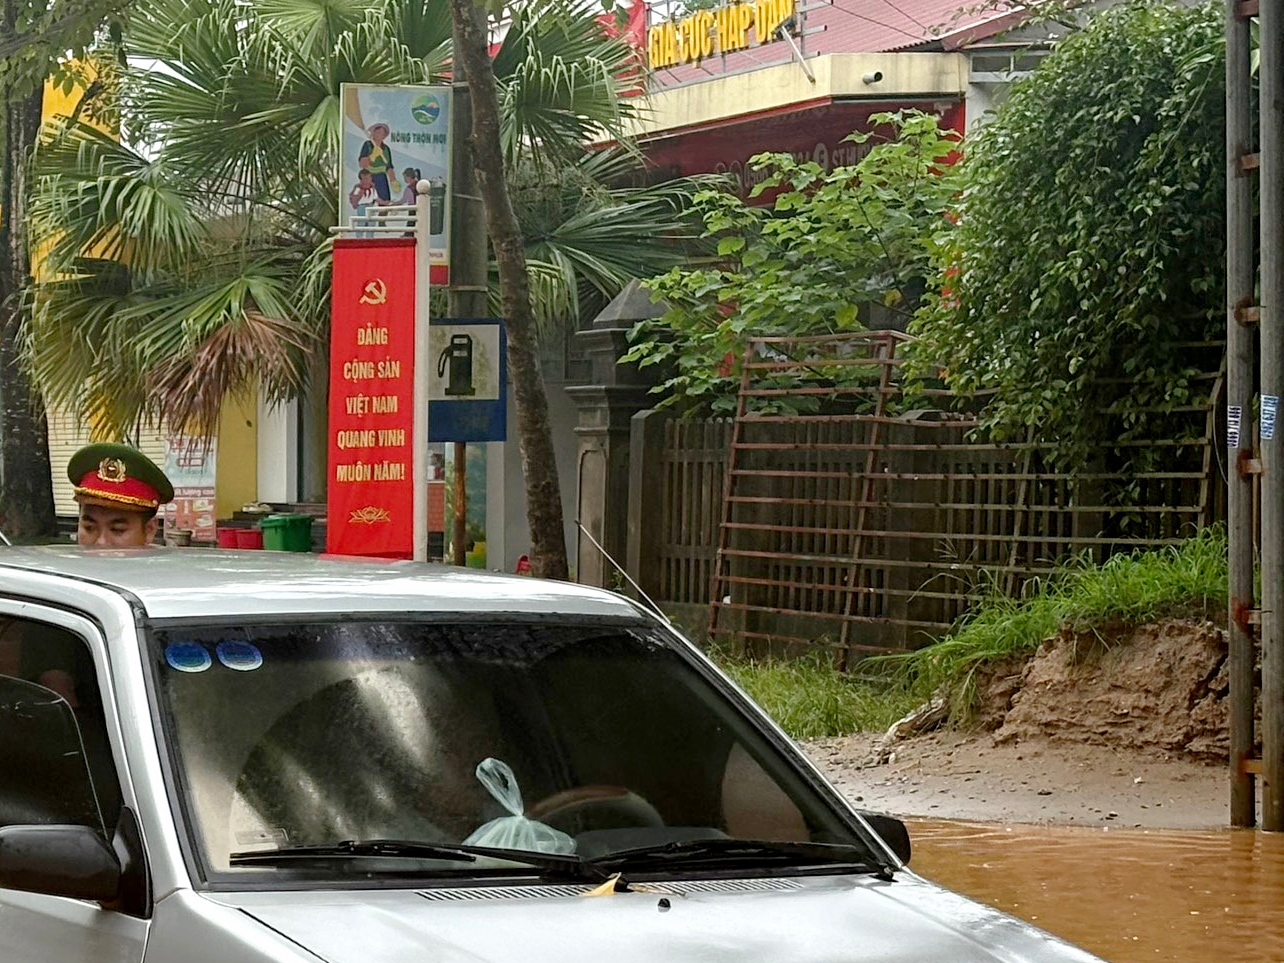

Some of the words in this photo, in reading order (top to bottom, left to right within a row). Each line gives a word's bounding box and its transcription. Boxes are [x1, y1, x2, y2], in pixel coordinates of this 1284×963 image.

[357, 322, 388, 346] ĐẢNG
[343, 358, 375, 383] CỘNG
[377, 356, 400, 379] SẢN
[346, 393, 368, 418] VIỆT
[372, 396, 398, 414] NAM
[337, 430, 375, 450] QUANG
[377, 429, 405, 447] VINH
[336, 461, 371, 482] MUÔN
[374, 461, 405, 481] NĂM!
